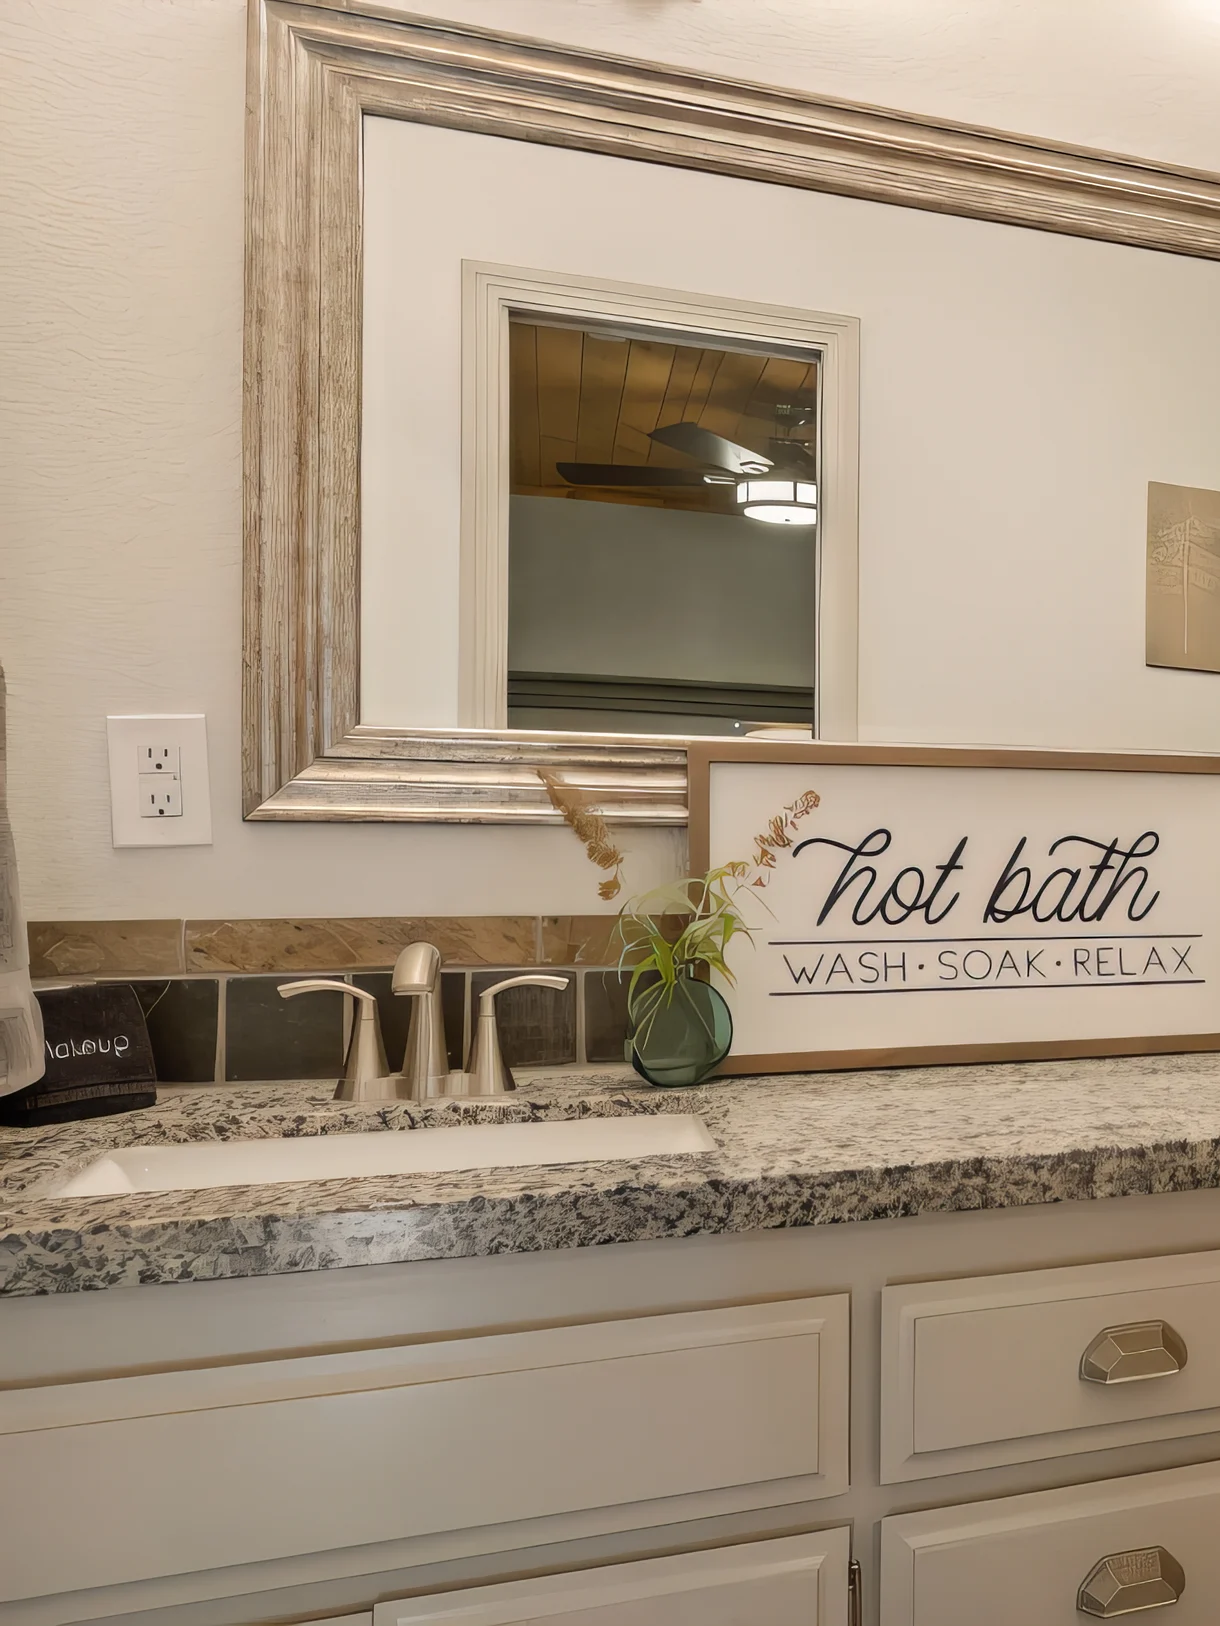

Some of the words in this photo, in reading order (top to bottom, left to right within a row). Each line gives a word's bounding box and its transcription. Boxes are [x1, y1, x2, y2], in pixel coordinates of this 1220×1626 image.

[791, 828, 969, 927] hot
[982, 830, 1161, 924] bath
[782, 951, 906, 985] WASH
[937, 949, 1046, 981] SOAK
[1073, 945, 1194, 977] RELAX
